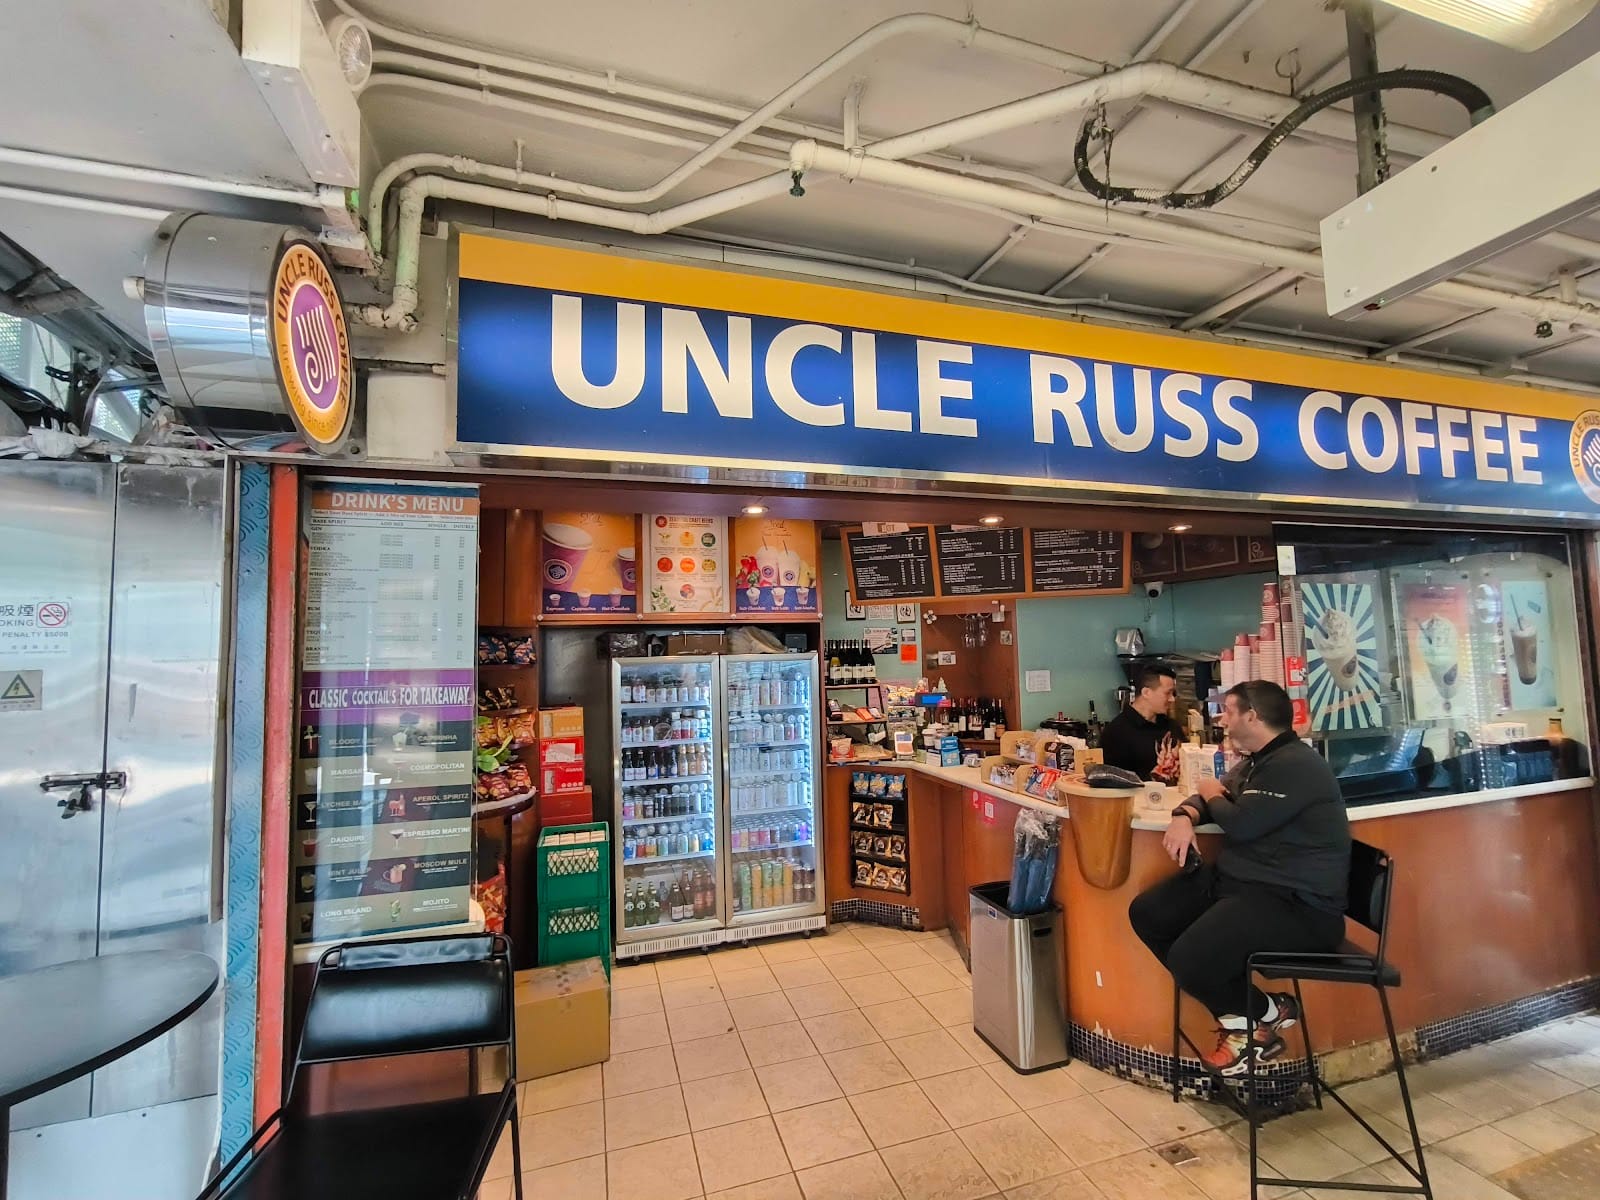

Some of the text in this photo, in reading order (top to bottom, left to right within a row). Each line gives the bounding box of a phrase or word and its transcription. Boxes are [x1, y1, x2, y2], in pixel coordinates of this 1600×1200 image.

[277, 253, 350, 409] UNCLE RUSS COFFEE
[551, 294, 1544, 486] UNCLE RUSS COFFEE
[331, 492, 465, 513] DRINK'S MENU
[308, 686, 470, 709] CLASSIC COCKTAIL'S FOR TAKEAWAY
[402, 827, 441, 838] ESPRESSO
[413, 857, 468, 869] MOSCOW MULE
[422, 897, 451, 907] MOJITO
[344, 905, 373, 916] ISLAND
